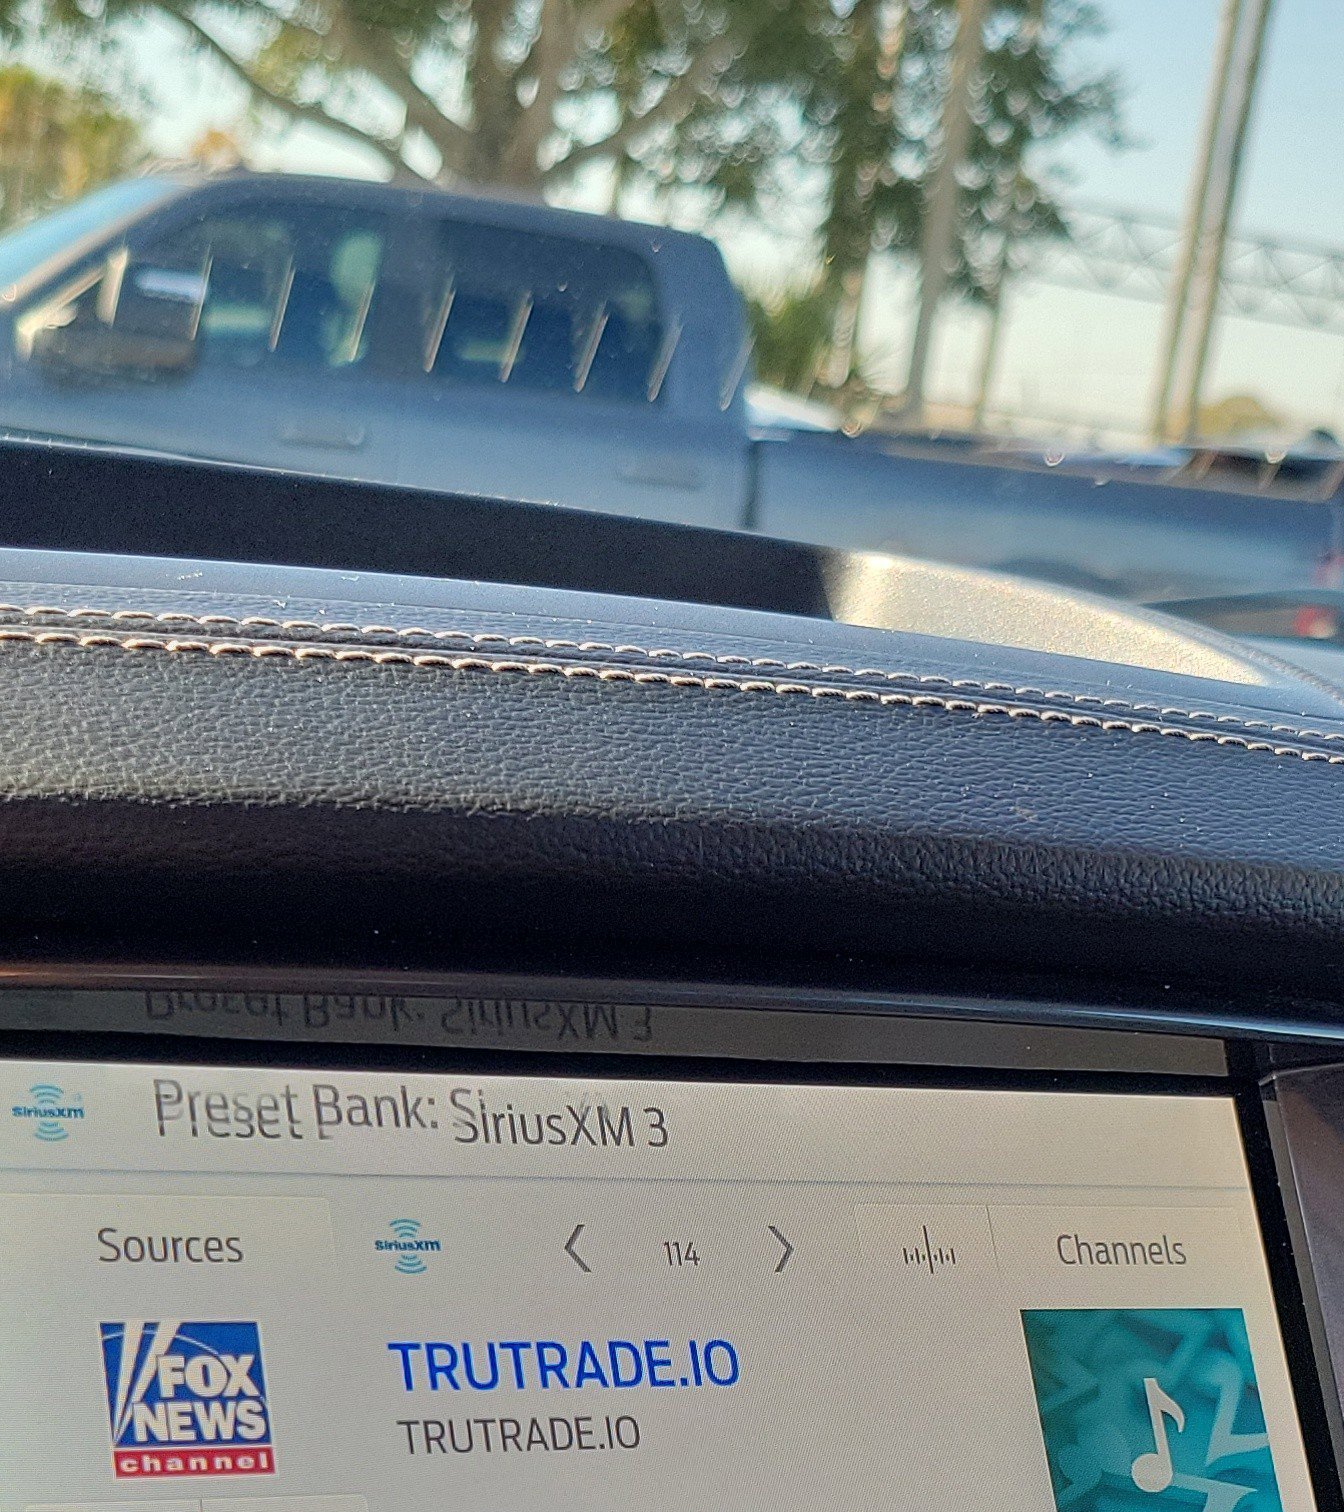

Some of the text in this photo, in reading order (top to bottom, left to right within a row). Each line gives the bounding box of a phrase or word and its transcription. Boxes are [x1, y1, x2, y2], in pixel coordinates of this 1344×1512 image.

[153, 1079, 670, 1148] Preset Bank: SiriusXM 3
[97, 1228, 244, 1265] Sources
[664, 1241, 701, 1267] 114
[1056, 1234, 1188, 1267] Channels
[156, 1355, 261, 1400] FOX
[387, 1338, 740, 1391] TRUTRADE.IO
[132, 1399, 267, 1444] NEWS
[397, 1414, 641, 1455] TRUTRADE.IO
[120, 1451, 269, 1473] channel
